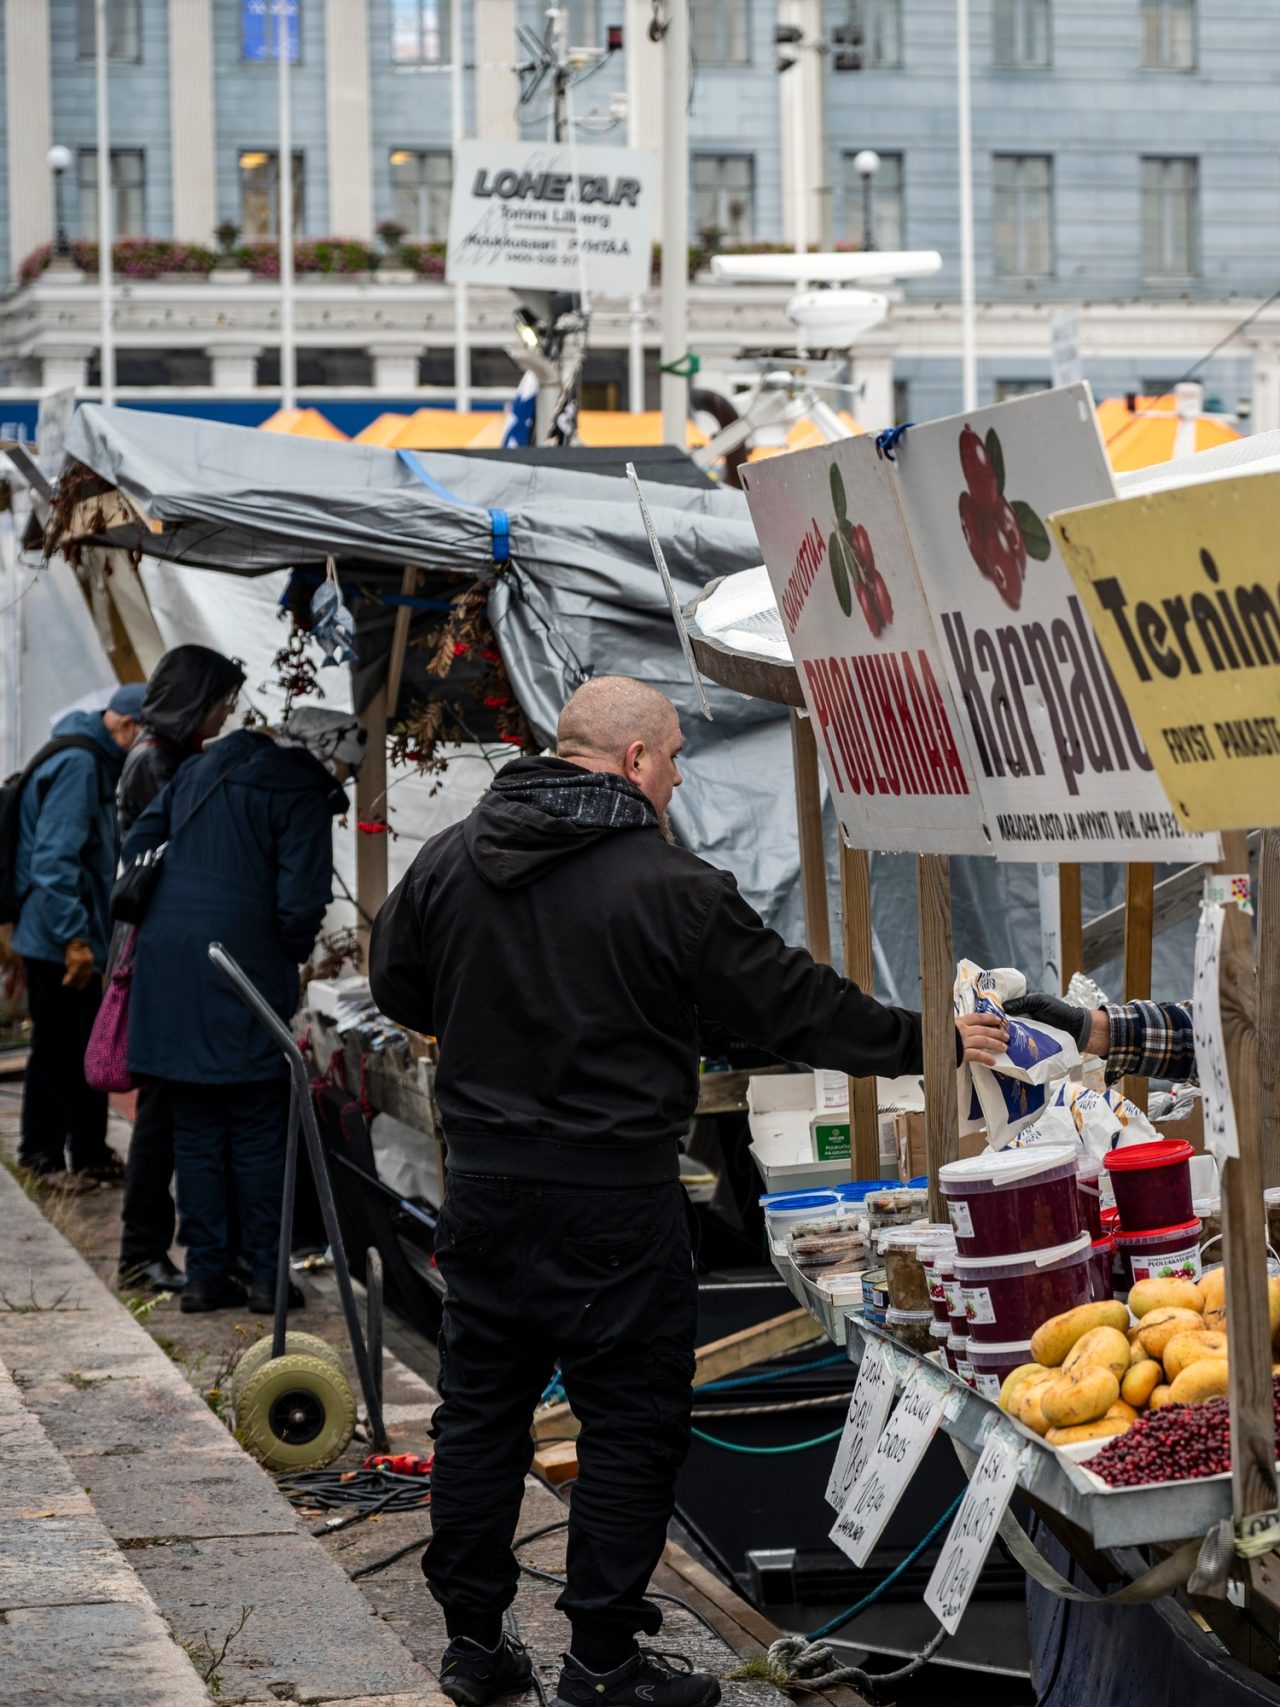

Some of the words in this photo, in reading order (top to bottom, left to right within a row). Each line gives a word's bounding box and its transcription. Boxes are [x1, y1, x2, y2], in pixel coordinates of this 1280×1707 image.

[472, 168, 641, 207] LOHETAR
[781, 517, 827, 634] SURVOTTUA
[802, 650, 970, 796] PUOLUKKAA
[1162, 723, 1216, 764] FRYST
[997, 813, 1042, 842] MARJOJEN
[1039, 812, 1065, 841] OSTO
[1063, 812, 1079, 842] JA
[1076, 810, 1116, 841] MYYNTI
[1114, 809, 1141, 840] PUH.
[1138, 811, 1161, 839] 044
[877, 1418, 912, 1464] SURVOS
[950, 1492, 997, 1543] NAURIS
